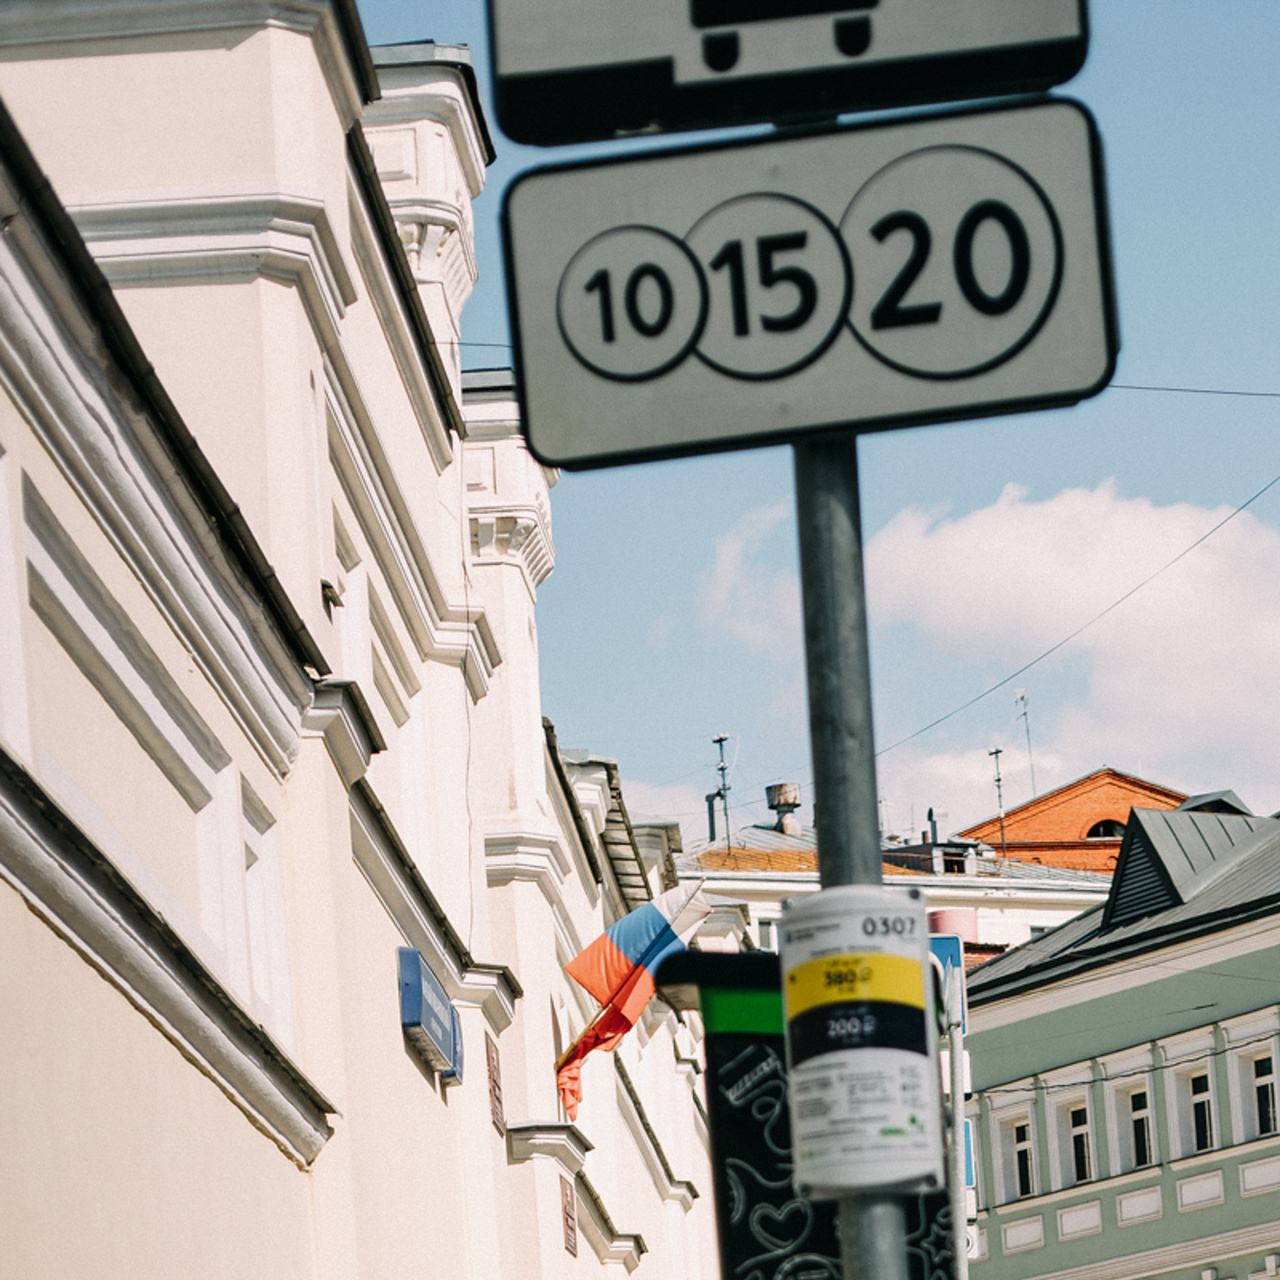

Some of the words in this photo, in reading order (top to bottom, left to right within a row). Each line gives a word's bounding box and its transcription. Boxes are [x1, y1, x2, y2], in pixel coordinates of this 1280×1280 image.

[584, 261, 674, 344] 10
[709, 231, 818, 338] 15
[870, 199, 1030, 331] 20
[862, 917, 916, 936] 0307
